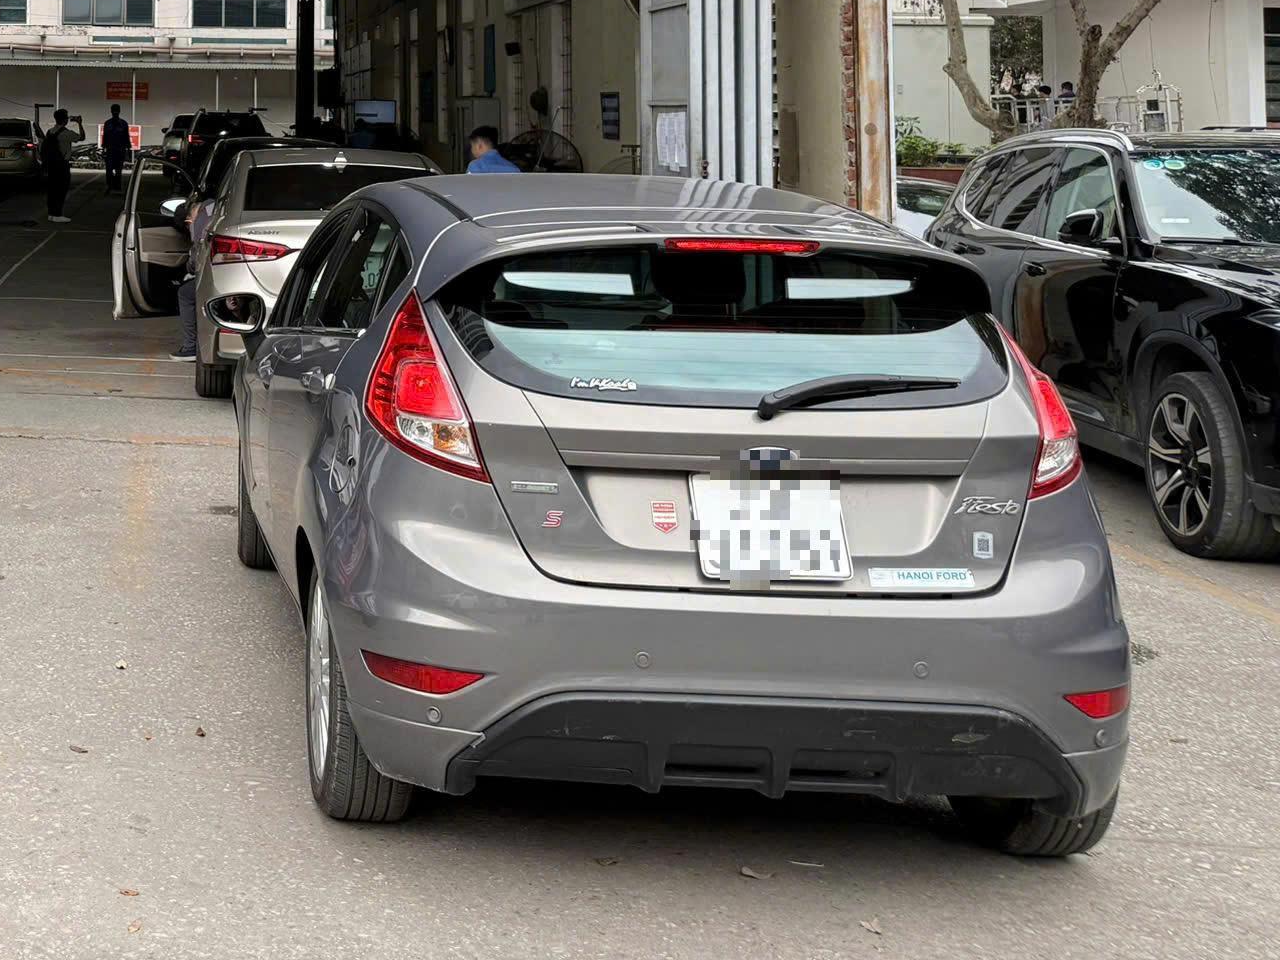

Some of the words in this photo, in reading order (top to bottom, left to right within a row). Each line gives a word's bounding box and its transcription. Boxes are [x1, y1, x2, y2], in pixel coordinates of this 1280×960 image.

[954, 496, 1021, 515] Fiesta
[541, 510, 564, 528] S
[897, 571, 933, 581] HANOI
[936, 571, 967, 580] FORD
